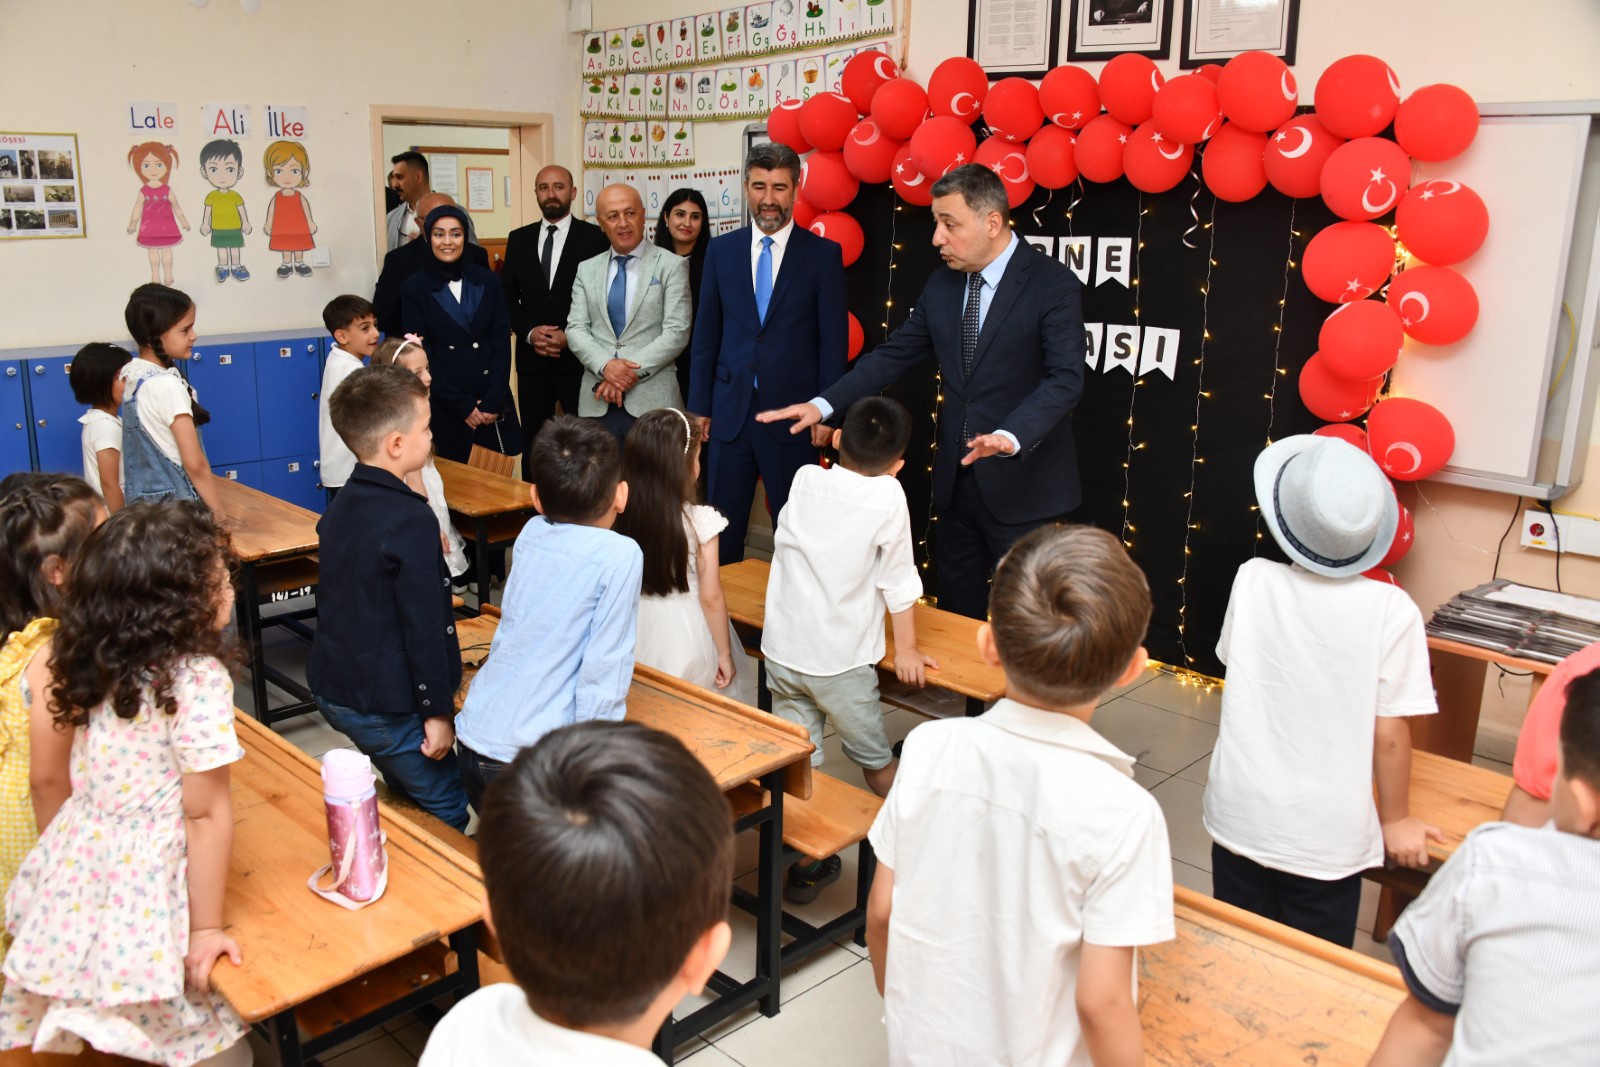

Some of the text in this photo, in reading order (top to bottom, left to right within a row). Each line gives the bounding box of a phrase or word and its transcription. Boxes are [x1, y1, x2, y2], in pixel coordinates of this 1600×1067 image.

[130, 106, 175, 129] Lale
[213, 108, 245, 135] Ali
[267, 105, 304, 137] İlke
[721, 188, 731, 206] 6
